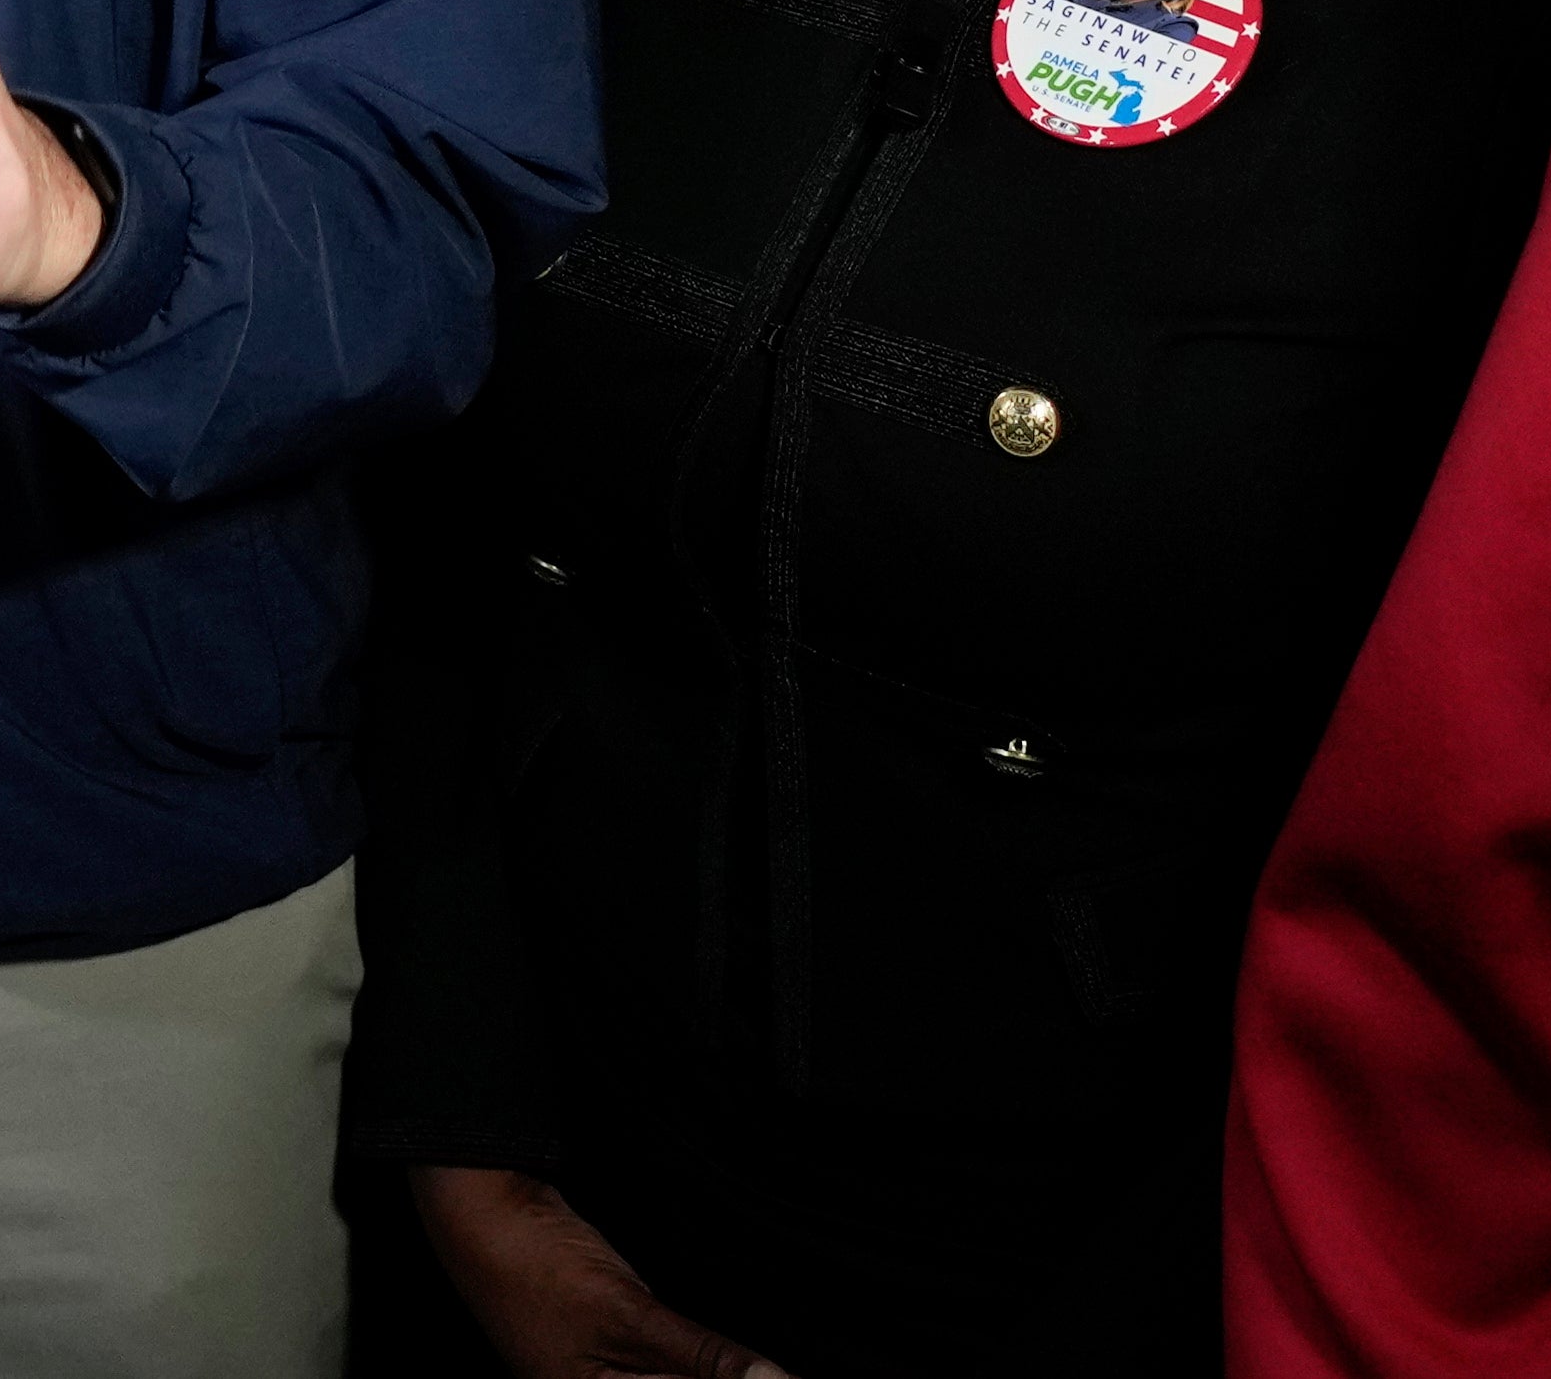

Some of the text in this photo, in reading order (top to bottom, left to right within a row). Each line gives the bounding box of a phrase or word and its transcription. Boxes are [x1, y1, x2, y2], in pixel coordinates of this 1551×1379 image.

[1021, 11, 1197, 86] THE SENATE!
[1166, 40, 1197, 63] TO
[1040, 49, 1100, 82] PAMELA
[1024, 61, 1124, 112] PUGH
[1031, 84, 1094, 113] U.S. SENATE
